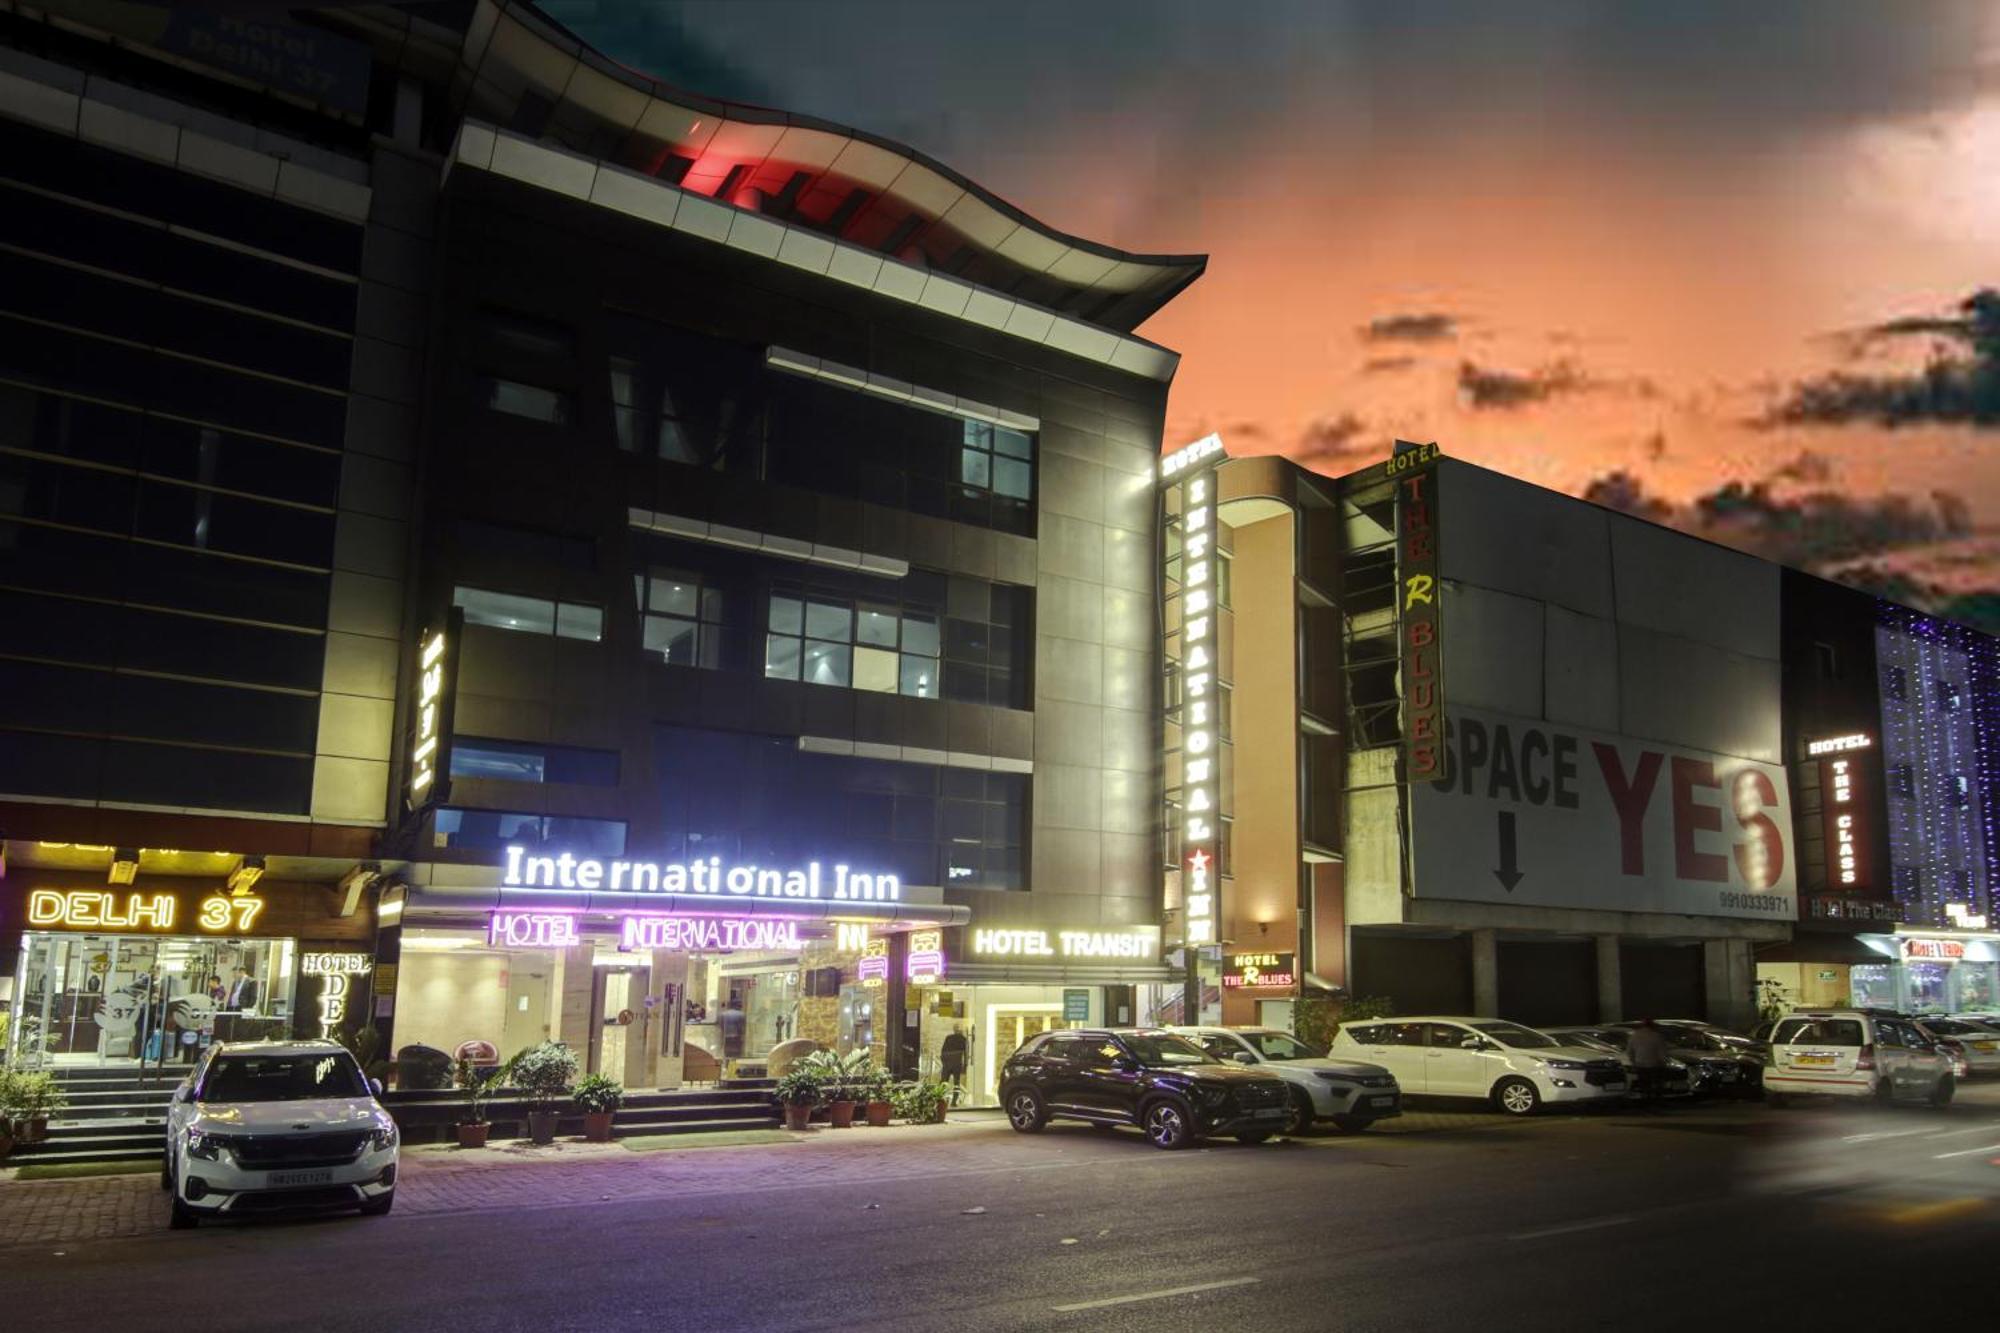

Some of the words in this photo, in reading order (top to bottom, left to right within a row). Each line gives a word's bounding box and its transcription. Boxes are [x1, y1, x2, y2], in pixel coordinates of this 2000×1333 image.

[1162, 432, 1224, 476] HOTEL
[1386, 442, 1440, 476] HOTEL
[1403, 473, 1432, 561] THE
[1406, 574, 1433, 612] R
[1186, 479, 1211, 841] INTERNATIONAL
[1409, 622, 1437, 775] BLUES
[1431, 716, 1580, 810] SPACE
[1809, 734, 1871, 755] HOTEL
[1832, 761, 1850, 802] THE
[1591, 741, 1785, 892] YES
[1837, 815, 1856, 883] CLASS
[504, 846, 820, 897] International
[834, 864, 899, 900] Inn
[29, 890, 174, 928] DELHI
[200, 897, 263, 930] 37
[1811, 898, 1844, 918] Htel
[491, 914, 580, 946] HOTEL
[975, 929, 1053, 955] HOTEL
[1059, 931, 1155, 958] TRANSIT
[302, 952, 372, 974] HOTEL
[1223, 975, 1243, 986] THE
[1243, 966, 1259, 985] R
[1258, 974, 1292, 985] BLUES
[1235, 955, 1279, 967] HOTEL
